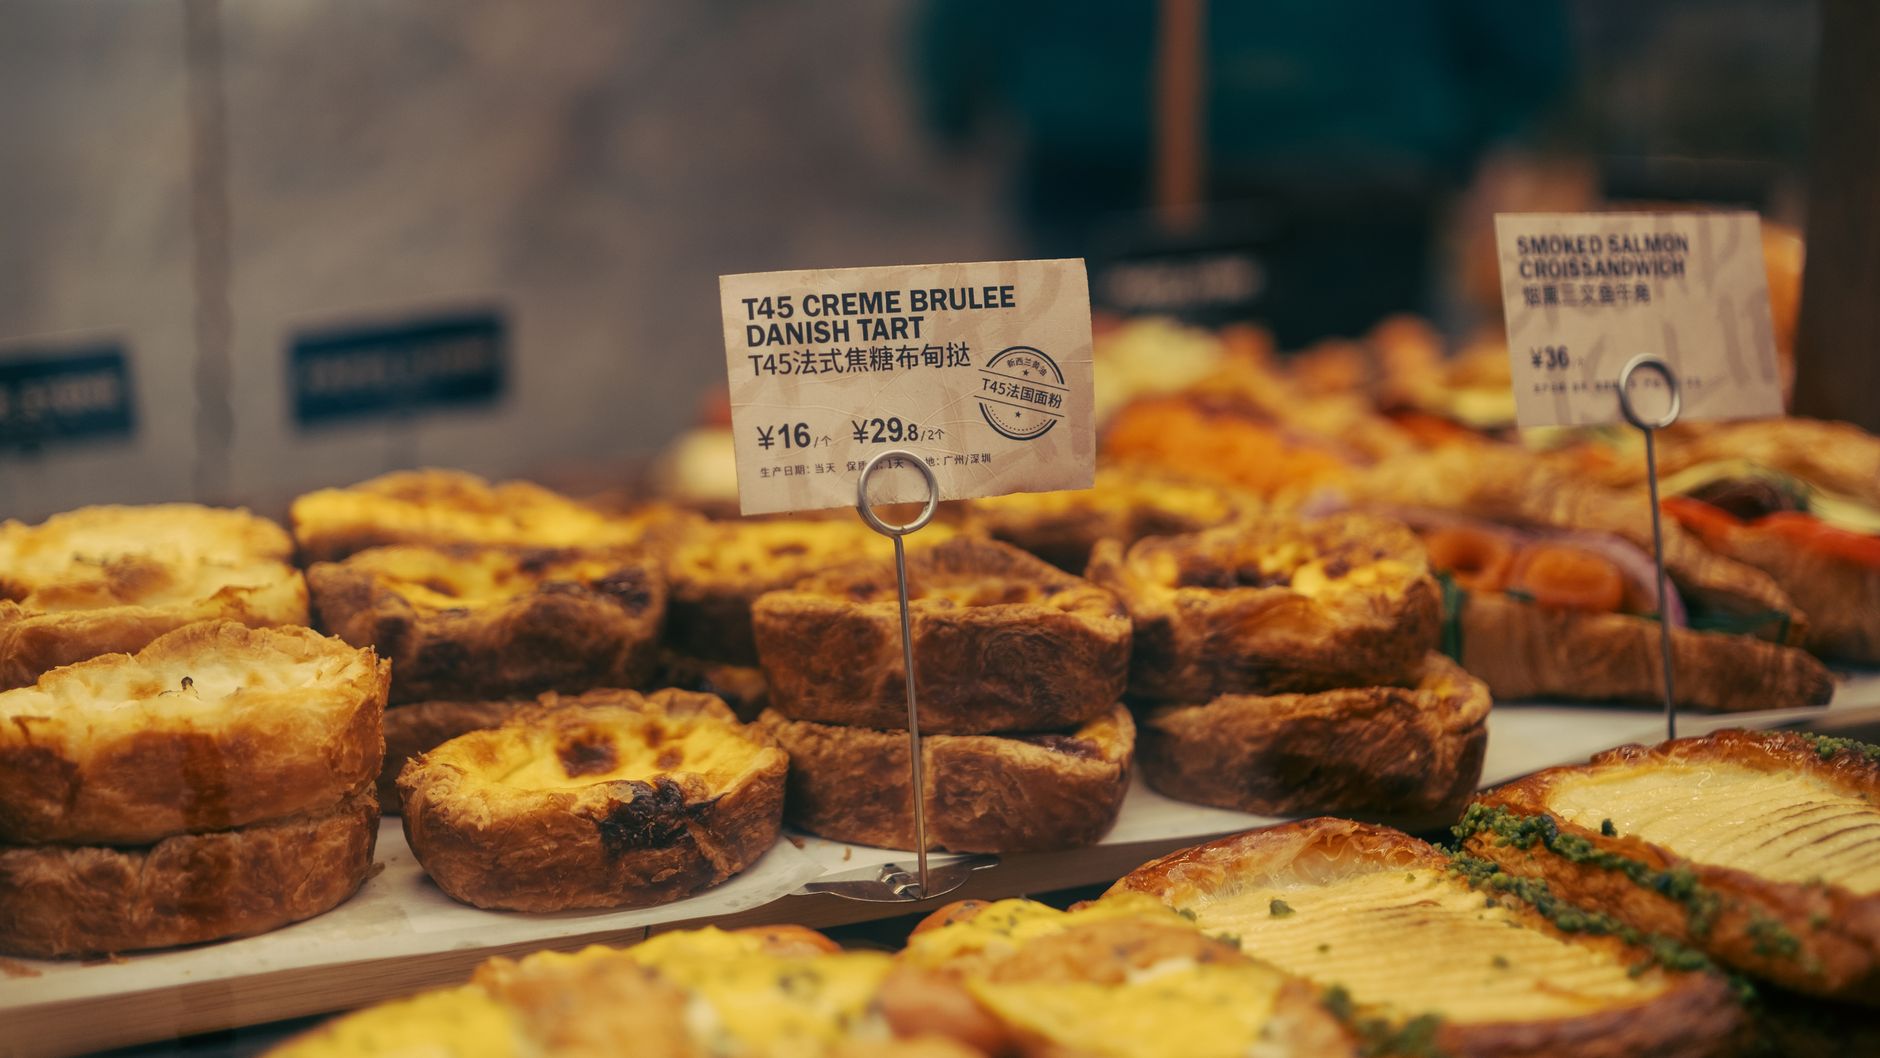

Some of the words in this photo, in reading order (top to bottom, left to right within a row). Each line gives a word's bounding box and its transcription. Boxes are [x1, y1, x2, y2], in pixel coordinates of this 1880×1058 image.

[1517, 234, 1602, 255] SMOKED
[1608, 232, 1689, 254] SALMON
[1519, 257, 1685, 279] CROISSANDWICH
[742, 296, 794, 320] T45
[803, 291, 901, 317] CREME
[910, 285, 1016, 312] BRULEE
[746, 320, 850, 347] DANISH
[857, 316, 924, 341] TART
[748, 341, 971, 376] T45法式焦糖布甸挞
[982, 378, 1062, 409] T45法国面粉
